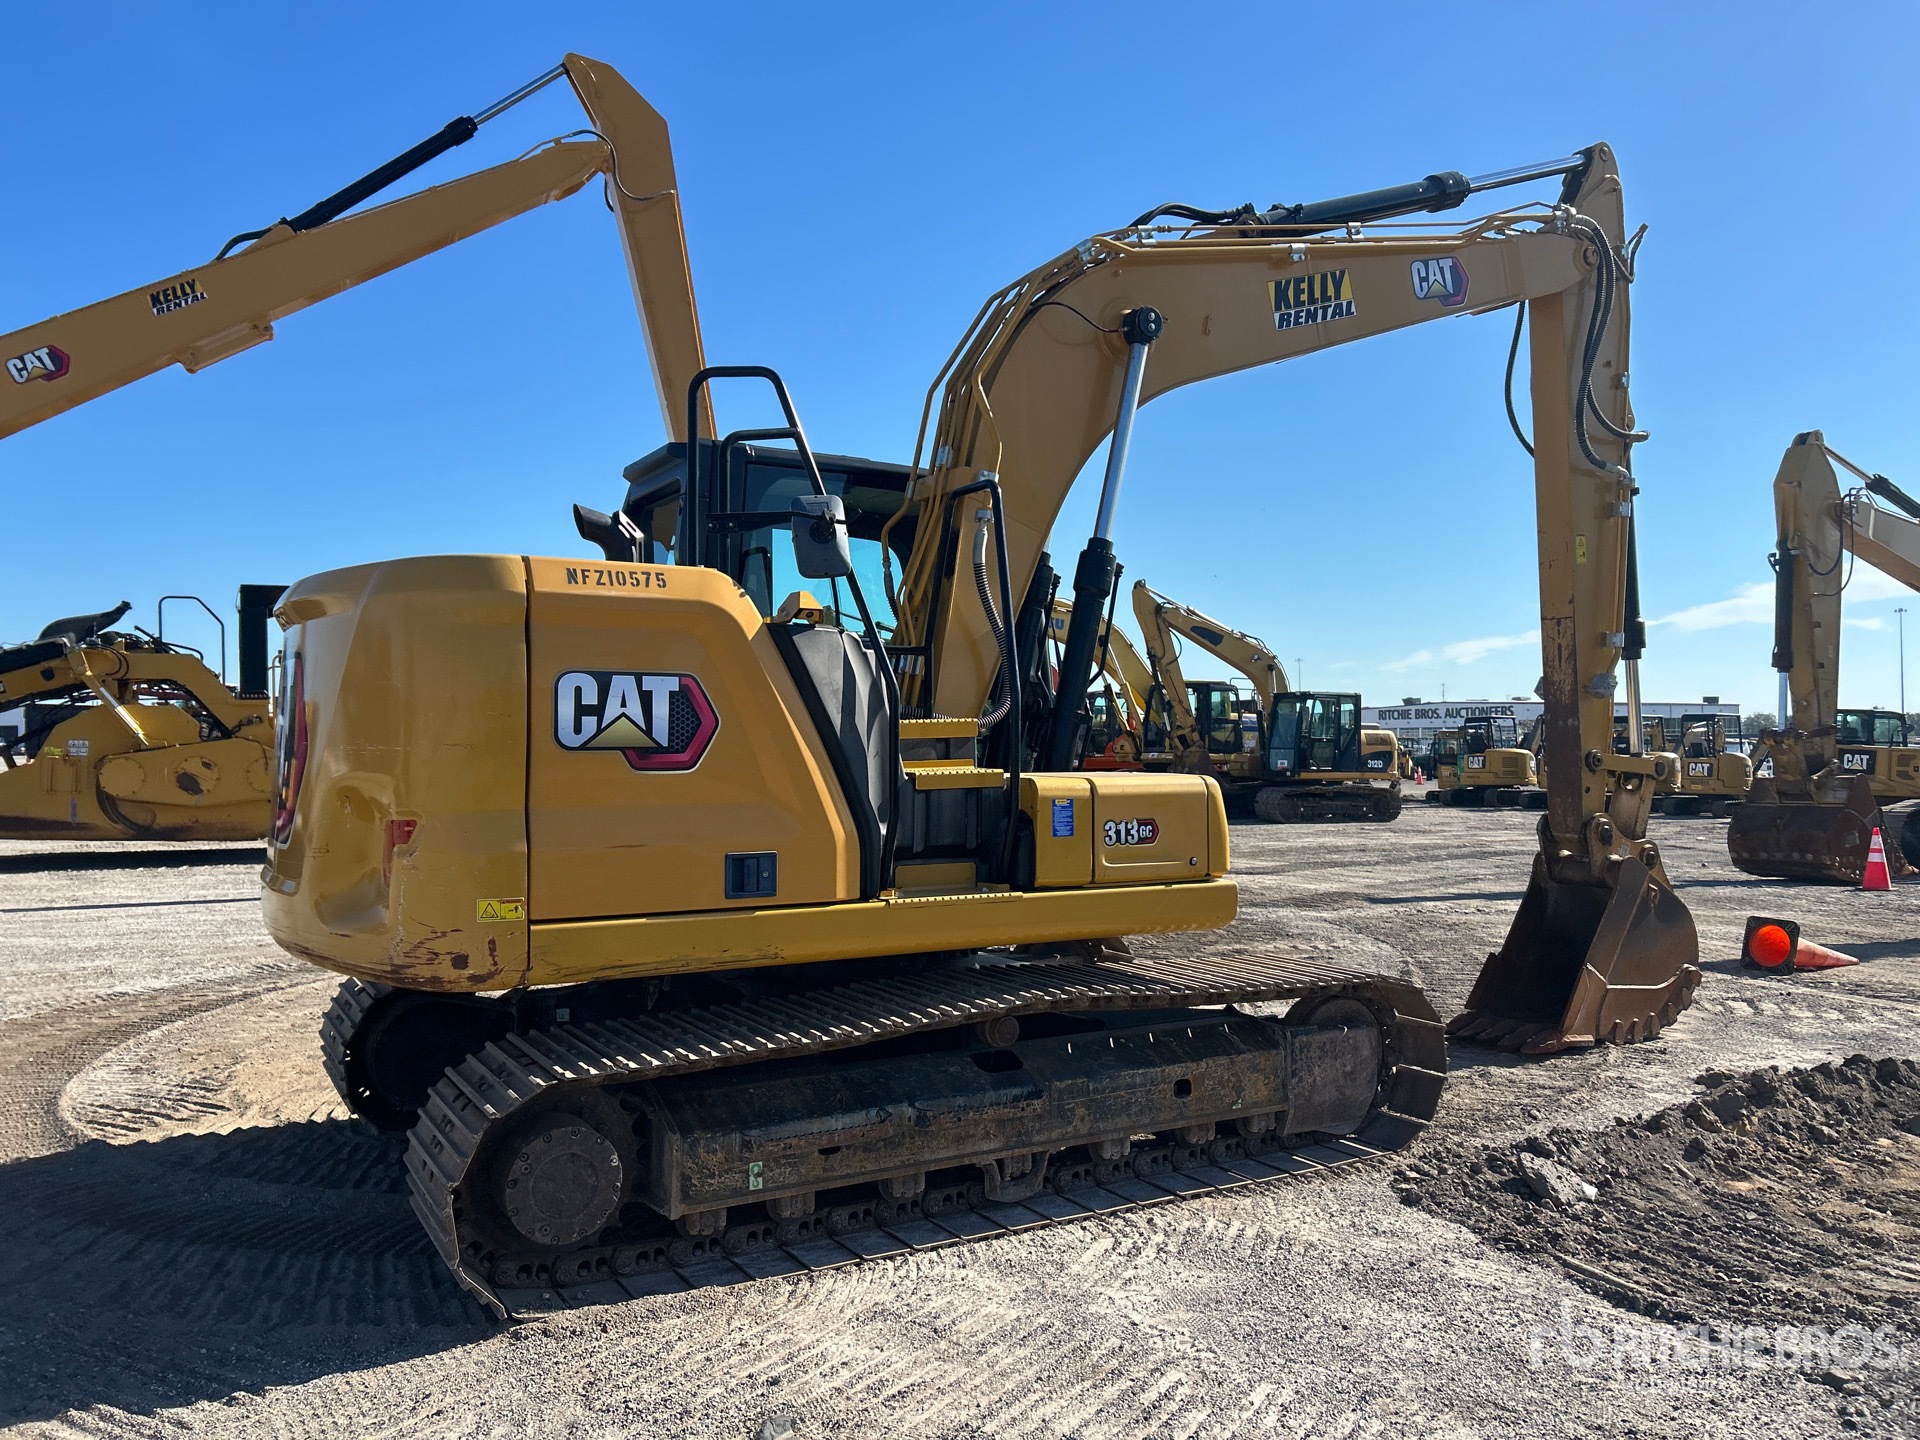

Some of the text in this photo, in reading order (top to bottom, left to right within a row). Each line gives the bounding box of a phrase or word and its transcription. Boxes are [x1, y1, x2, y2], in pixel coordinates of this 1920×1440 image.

[1274, 268, 1347, 312] KELLY
[1411, 257, 1454, 299] CAT
[149, 278, 197, 308] KELLY
[155, 291, 207, 316] RENTAL
[1277, 299, 1355, 330] RENTAL
[6, 347, 55, 384] CAT
[557, 672, 681, 748] CAT
[1378, 705, 1514, 720] RITCHIE BROS. AUCTIONEERS
[1367, 760, 1383, 768] 312D
[1468, 756, 1484, 768] CAT
[1689, 763, 1710, 777] CAT
[1843, 753, 1870, 770] CAT
